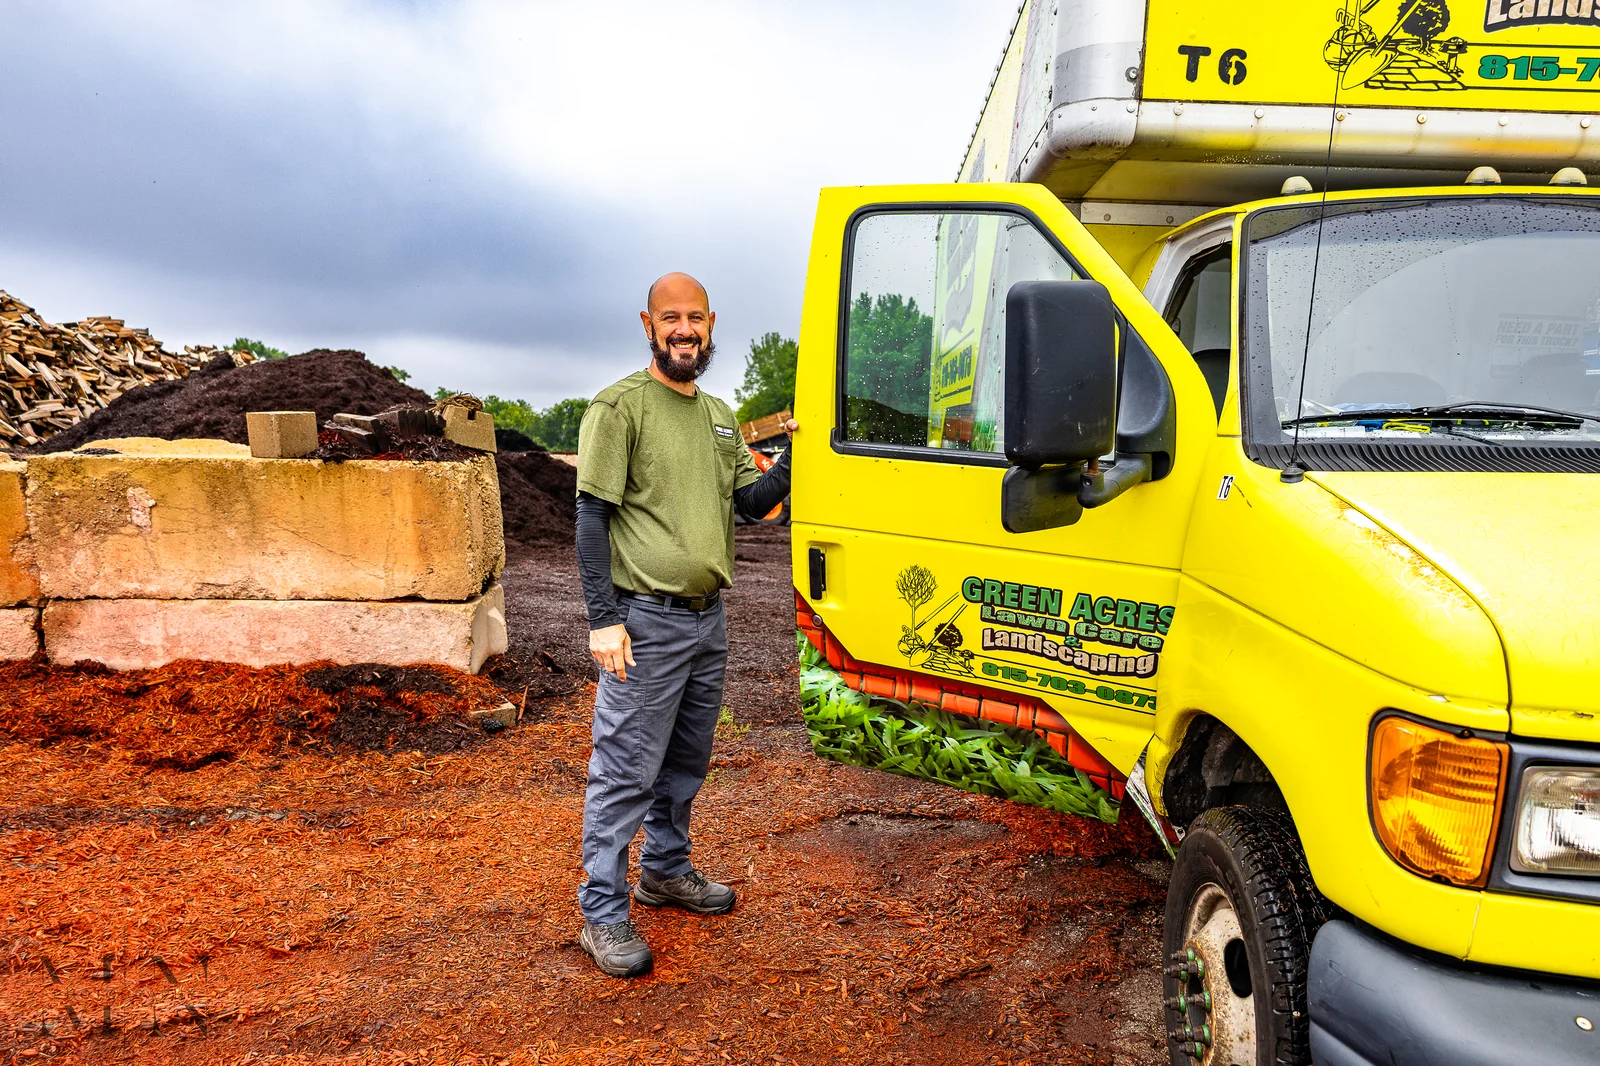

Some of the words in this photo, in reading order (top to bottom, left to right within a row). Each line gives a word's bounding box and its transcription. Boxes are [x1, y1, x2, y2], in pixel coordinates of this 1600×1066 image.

[1484, 0, 1600, 33] Land
[1478, 54, 1600, 82] 815-7
[1494, 335, 1515, 344] FOR
[1517, 335, 1539, 345] THIS
[1541, 336, 1579, 347] TRUCK?
[1497, 321, 1531, 334] NEED
[1532, 322, 1543, 334] A
[1545, 323, 1581, 336] PART
[1218, 475, 1233, 498] T6
[962, 576, 1062, 615] GREEN
[1069, 593, 1175, 636] ACRES
[980, 604, 1069, 636] Lawn
[1073, 620, 1165, 653] Care
[1064, 635, 1082, 649] &
[981, 627, 1158, 679] Landscaping
